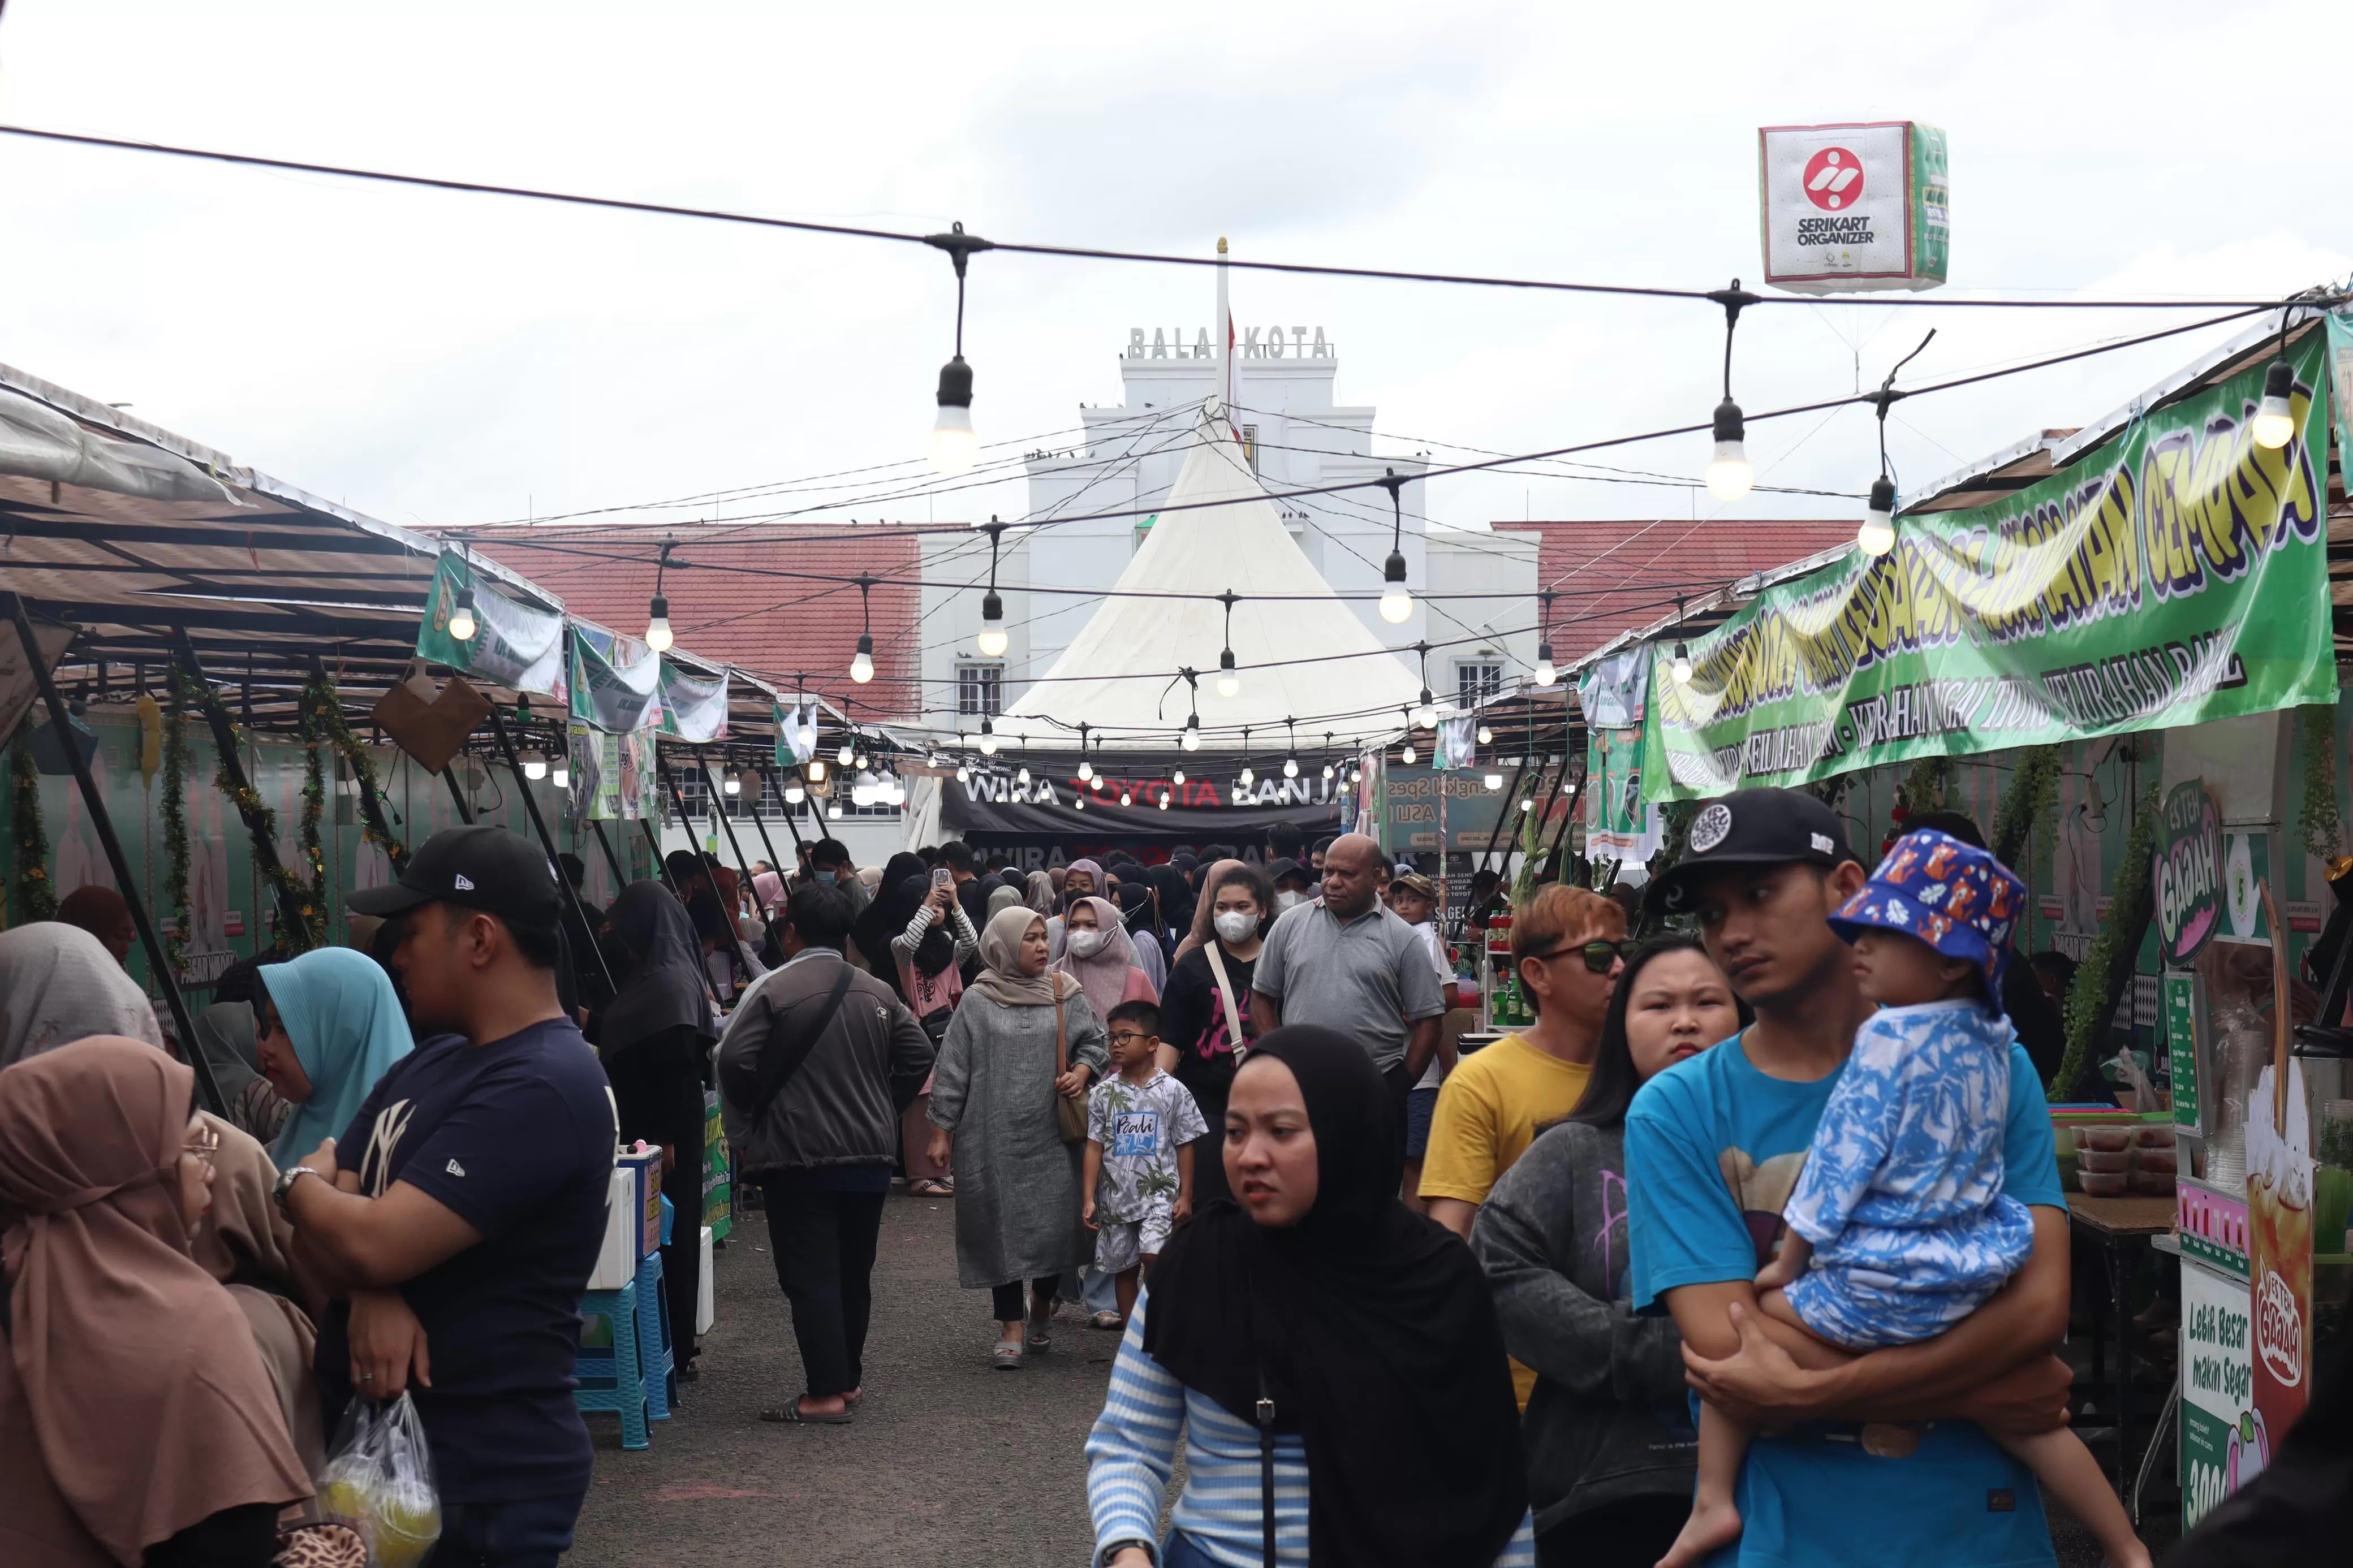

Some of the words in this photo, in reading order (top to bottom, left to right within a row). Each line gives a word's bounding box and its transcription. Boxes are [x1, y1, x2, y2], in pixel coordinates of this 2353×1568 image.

[1798, 217, 1871, 234] SERIKART
[1798, 231, 1874, 247] ORGANIZER
[1130, 327, 1212, 360] BALA
[1244, 326, 1329, 359] KOTA
[964, 776, 1061, 805] WIRA
[1068, 778, 1221, 807] TOYOTA
[2169, 796, 2180, 831] ES
[2180, 787, 2200, 829] TEH
[2159, 824, 2217, 943] GAJAH
[1116, 1113, 1155, 1135] Bali
[2272, 1277, 2278, 1300] ES
[2279, 1282, 2292, 1315] TEH
[2190, 1301, 2216, 1344] Lebih
[2219, 1306, 2248, 1350] Besar
[2260, 1299, 2299, 1370] GAJAH
[2193, 1354, 2221, 1394] makin
[2224, 1356, 2252, 1407] Segar
